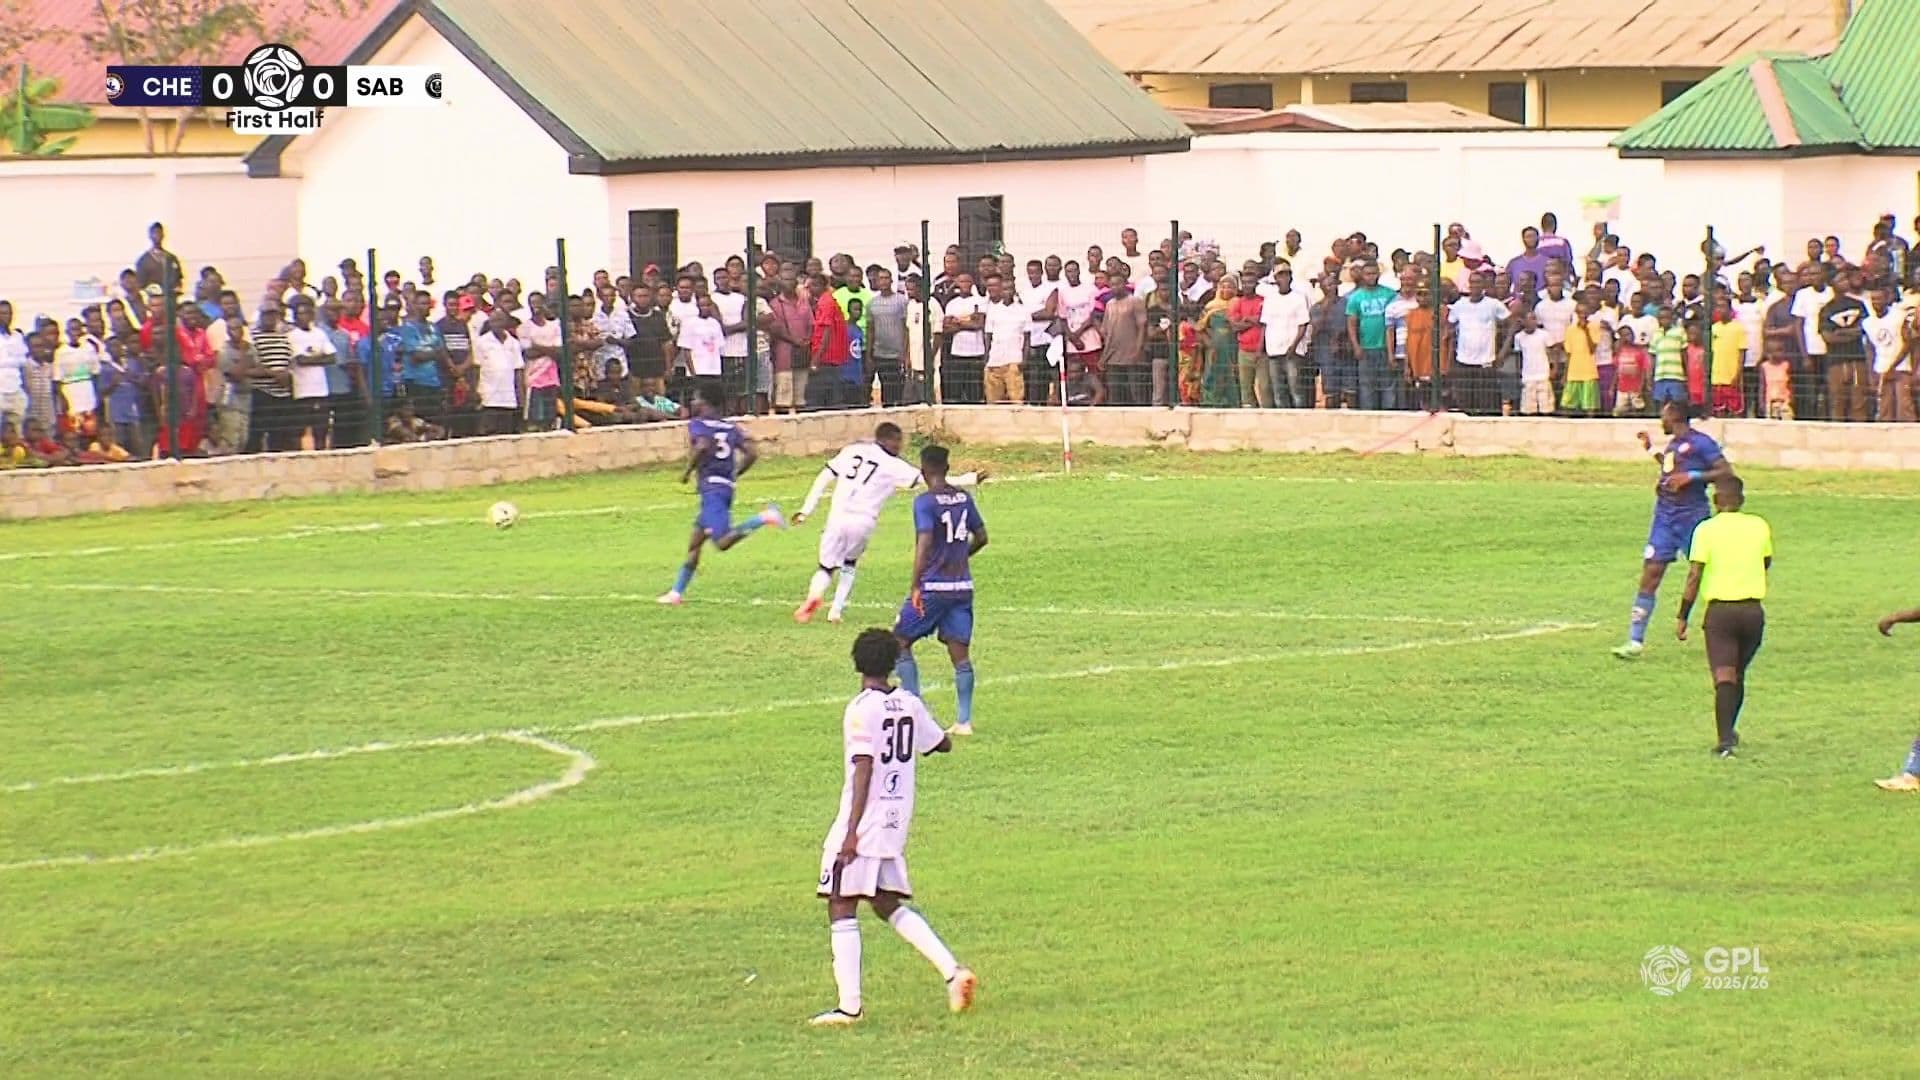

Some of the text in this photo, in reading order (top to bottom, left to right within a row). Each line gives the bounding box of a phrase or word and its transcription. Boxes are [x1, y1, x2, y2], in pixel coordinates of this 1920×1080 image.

[714, 433, 731, 459] 3
[846, 455, 879, 485] 37
[941, 510, 970, 544] 14
[880, 716, 914, 764] 30
